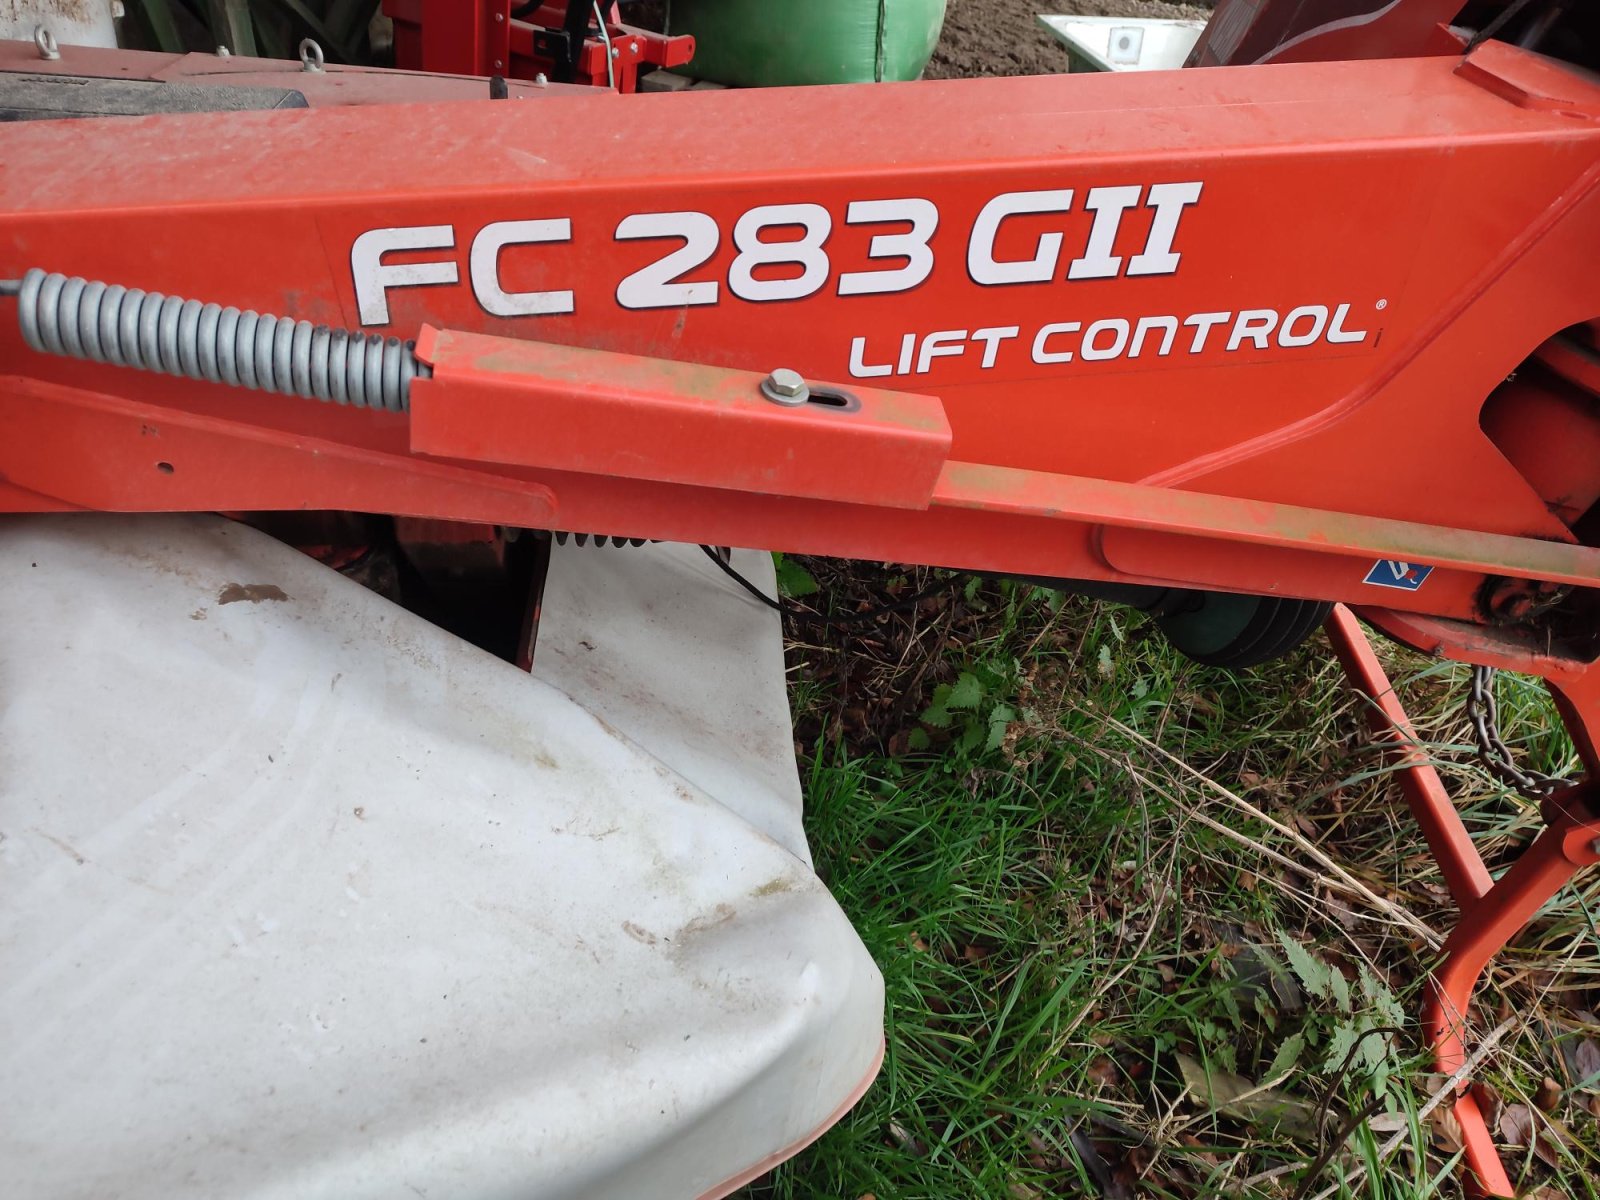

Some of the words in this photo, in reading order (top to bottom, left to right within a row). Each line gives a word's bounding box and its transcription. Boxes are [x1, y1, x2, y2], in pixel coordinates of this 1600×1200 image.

[350, 217, 575, 327] FC
[614, 197, 939, 310] 283
[966, 181, 1204, 286] GII
[848, 325, 1020, 379] LIFT
[1031, 303, 1368, 365] CONTROL
